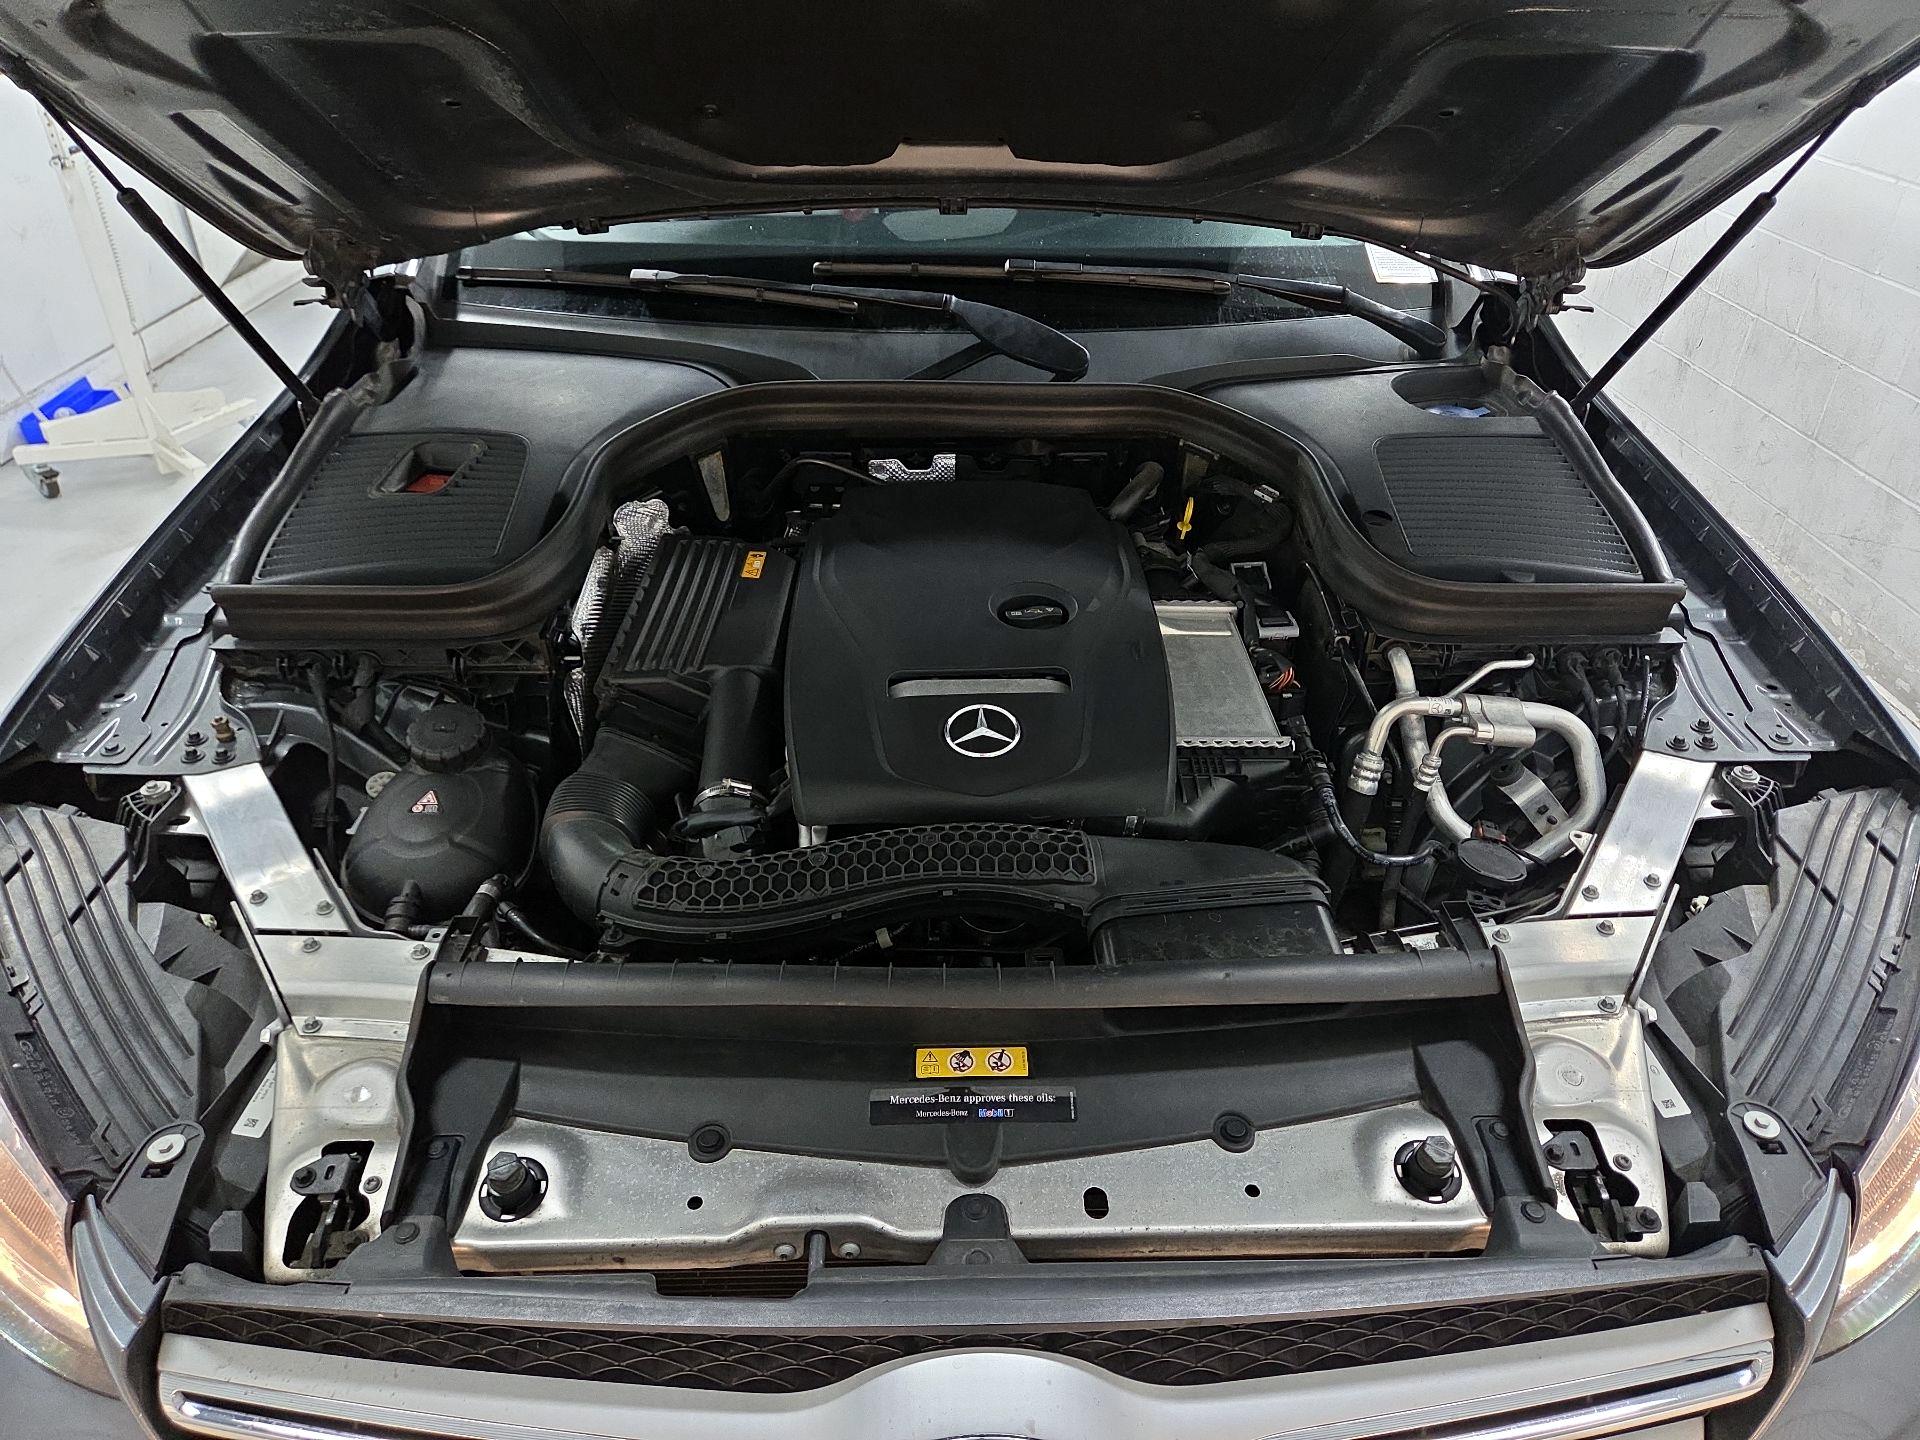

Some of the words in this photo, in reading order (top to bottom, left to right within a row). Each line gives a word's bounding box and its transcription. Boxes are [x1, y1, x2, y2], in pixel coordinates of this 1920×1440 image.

[889, 1093, 962, 1105] Mercedes-Benz
[963, 1093, 1006, 1104] approves
[1009, 1093, 1034, 1102] these
[1036, 1092, 1056, 1102] oils:
[915, 1109, 969, 1118] Mercedes-Benz
